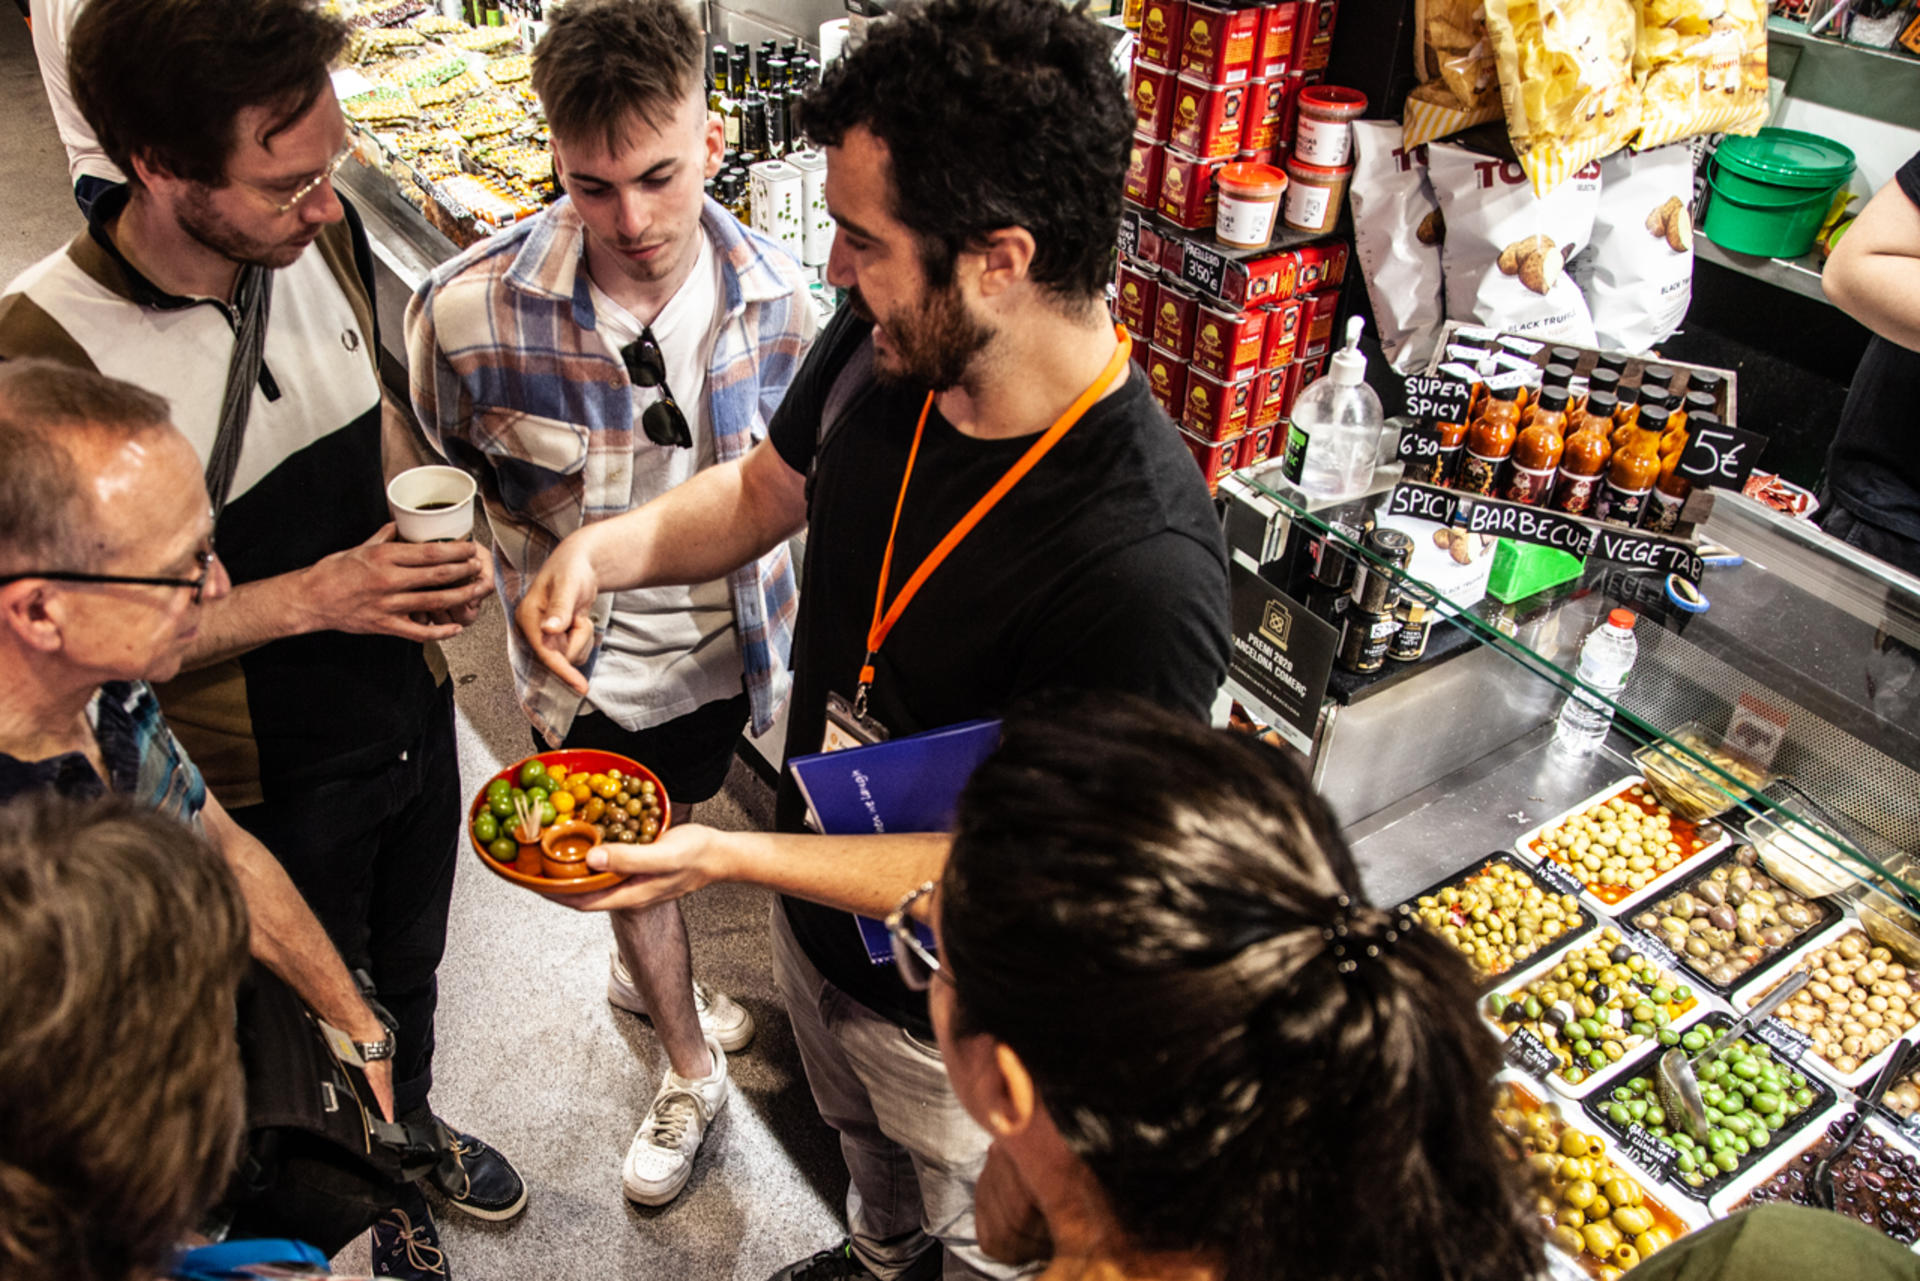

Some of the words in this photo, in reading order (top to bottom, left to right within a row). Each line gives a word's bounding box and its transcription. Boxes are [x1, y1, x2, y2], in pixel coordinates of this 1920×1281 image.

[1508, 319, 1540, 333] BLACK
[1404, 376, 1469, 400] SUPER
[1405, 396, 1461, 421] SPICY
[1681, 429, 1746, 478] 5€
[1393, 487, 1456, 524] SPICY
[1471, 504, 1590, 556] BARBECUE
[1604, 535, 1702, 580] VEGETAB
[1248, 632, 1274, 658] PREMI
[1273, 651, 1294, 673] 2020
[1274, 666, 1307, 698] COMERÇ
